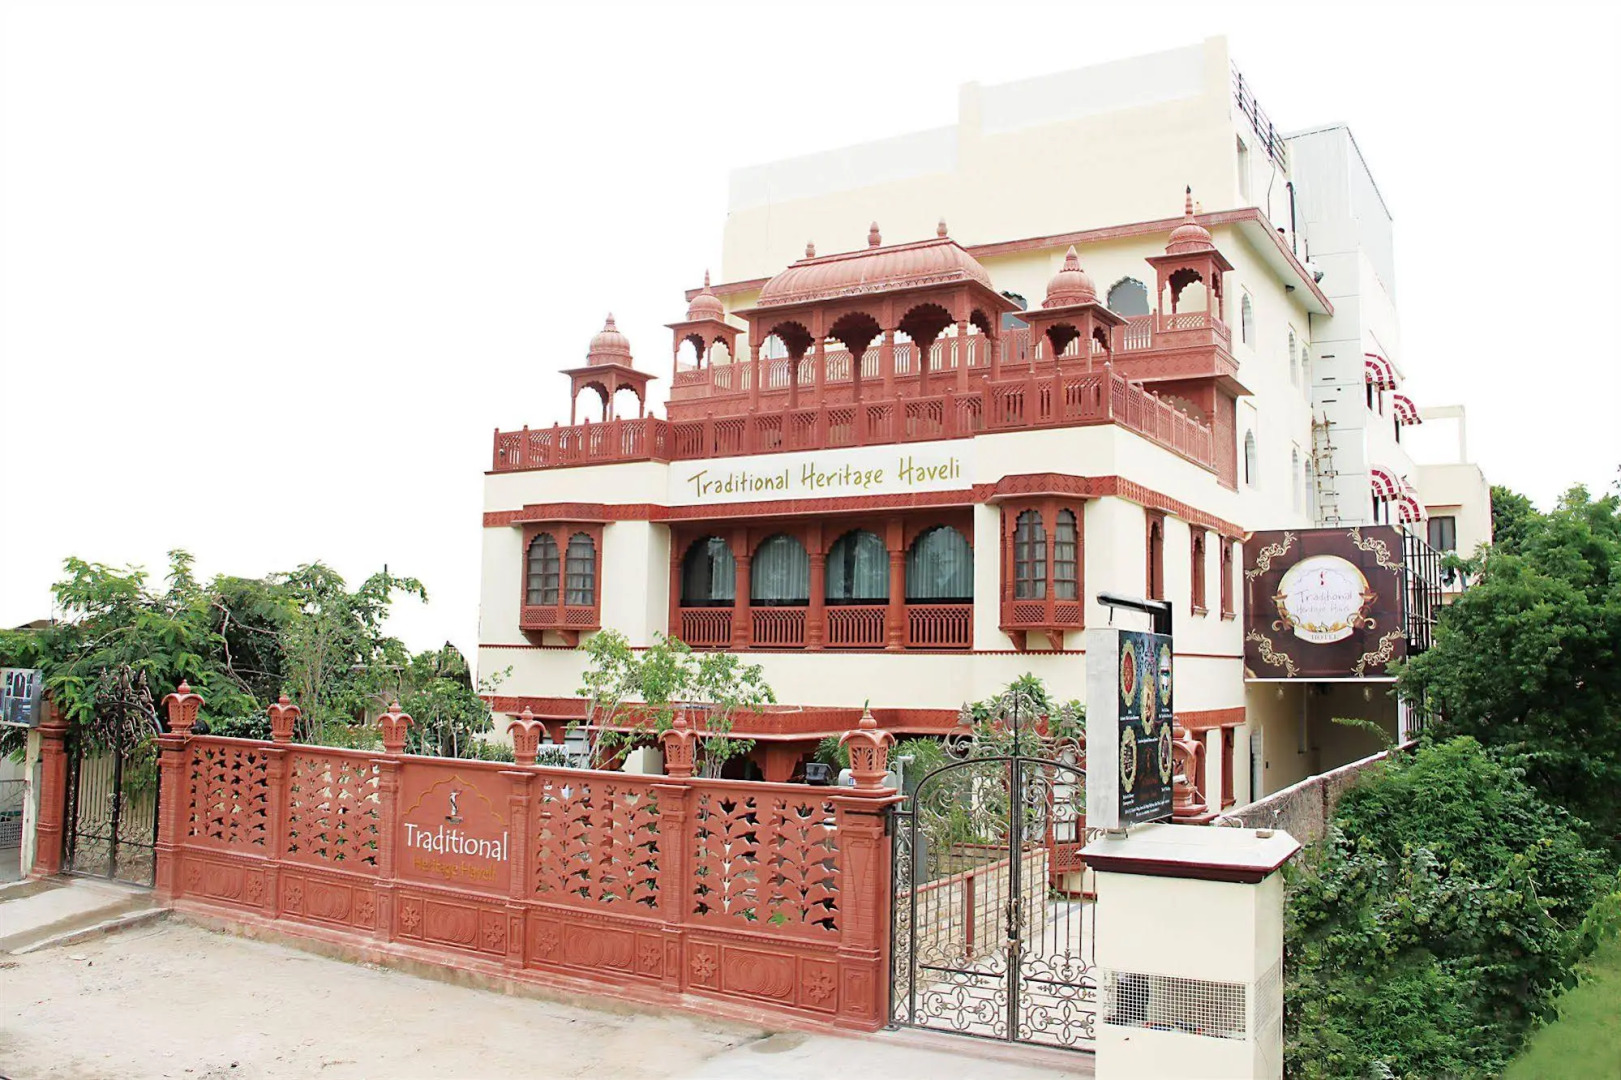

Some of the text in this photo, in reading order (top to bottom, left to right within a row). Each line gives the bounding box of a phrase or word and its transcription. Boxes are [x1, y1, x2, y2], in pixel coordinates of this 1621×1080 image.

[688, 456, 960, 497] Traditional Heritage Haveli
[404, 823, 508, 861] Traditional
